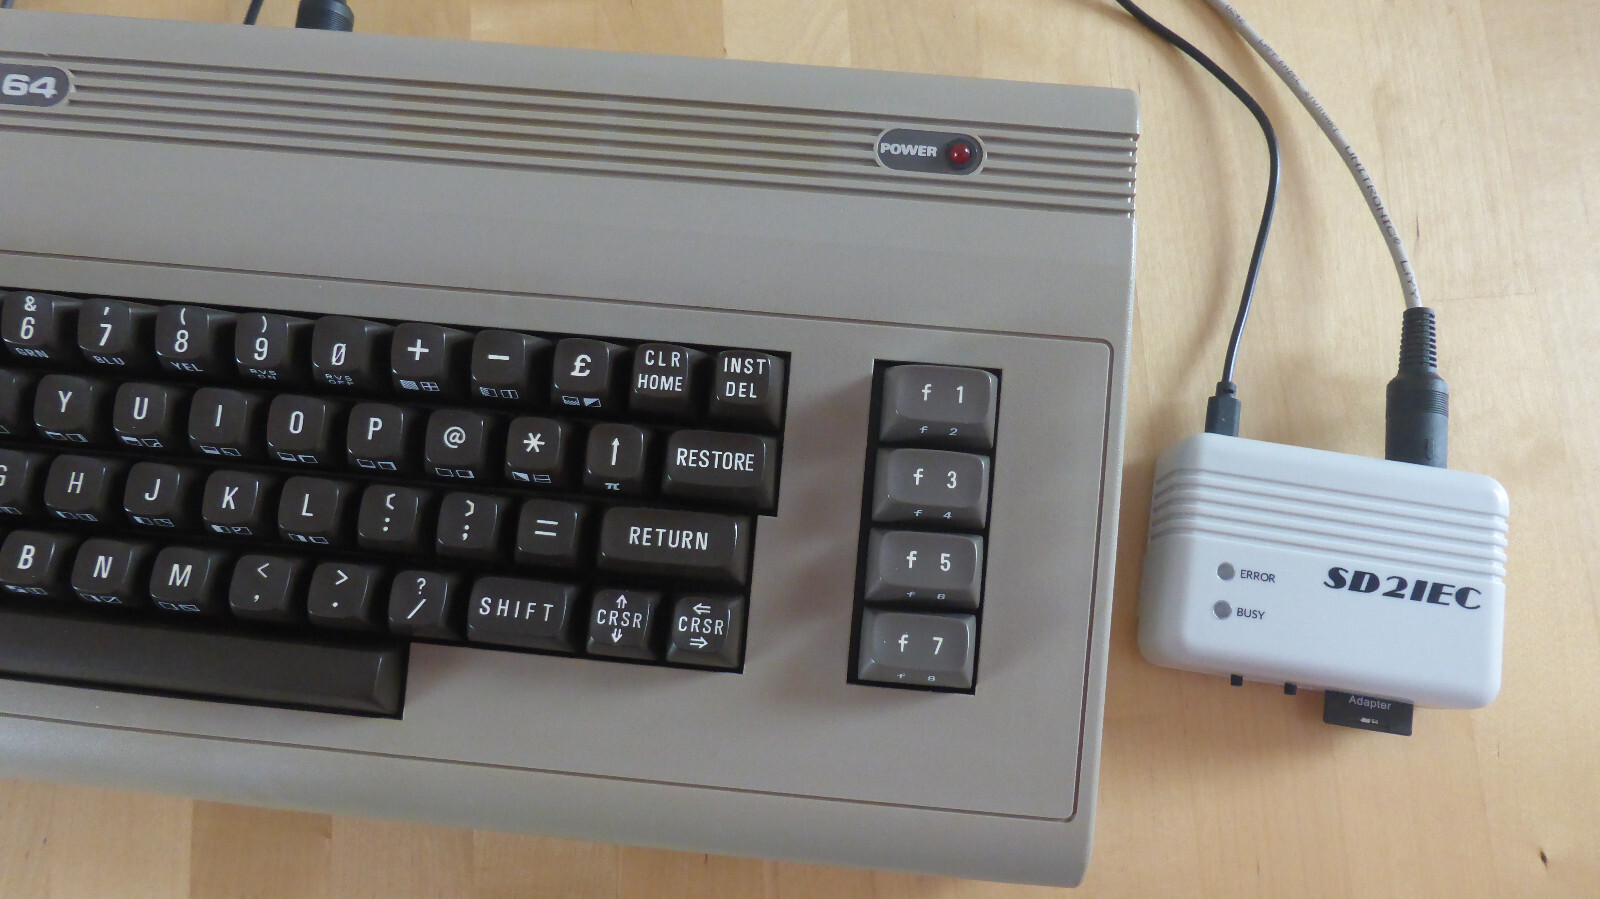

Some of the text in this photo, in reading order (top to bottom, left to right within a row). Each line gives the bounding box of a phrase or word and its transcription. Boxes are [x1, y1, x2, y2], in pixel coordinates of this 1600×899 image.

[2, 74, 57, 98] 64
[880, 142, 938, 157] POWER
[21, 317, 35, 339] 6
[99, 323, 113, 347] 7
[175, 330, 188, 352] 8
[254, 338, 268, 360] 9
[14, 347, 49, 359] GRN
[92, 355, 126, 366] BLU
[644, 349, 681, 368] CLR
[169, 361, 204, 372] YEL
[723, 356, 767, 375] INST
[637, 373, 683, 392] HOME
[725, 381, 758, 399] DEL
[59, 391, 72, 412] Y
[134, 397, 148, 419] U
[215, 404, 223, 427] I
[368, 418, 382, 440] P
[677, 448, 754, 471] RESTORE
[68, 472, 84, 493] H
[145, 479, 160, 500] J
[222, 487, 238, 509] K
[301, 493, 314, 517] L
[629, 527, 708, 550] RETURN
[17, 545, 35, 569] B
[93, 556, 112, 578] N
[169, 564, 192, 587] M
[1240, 569, 1276, 584] ERROR
[1324, 567, 1481, 609] SD2IEC
[480, 597, 553, 621] SHIFT
[597, 609, 642, 628] CRSR
[1236, 607, 1266, 620] BUSY
[679, 616, 723, 635] CRSR
[1349, 695, 1391, 710] Adapter
